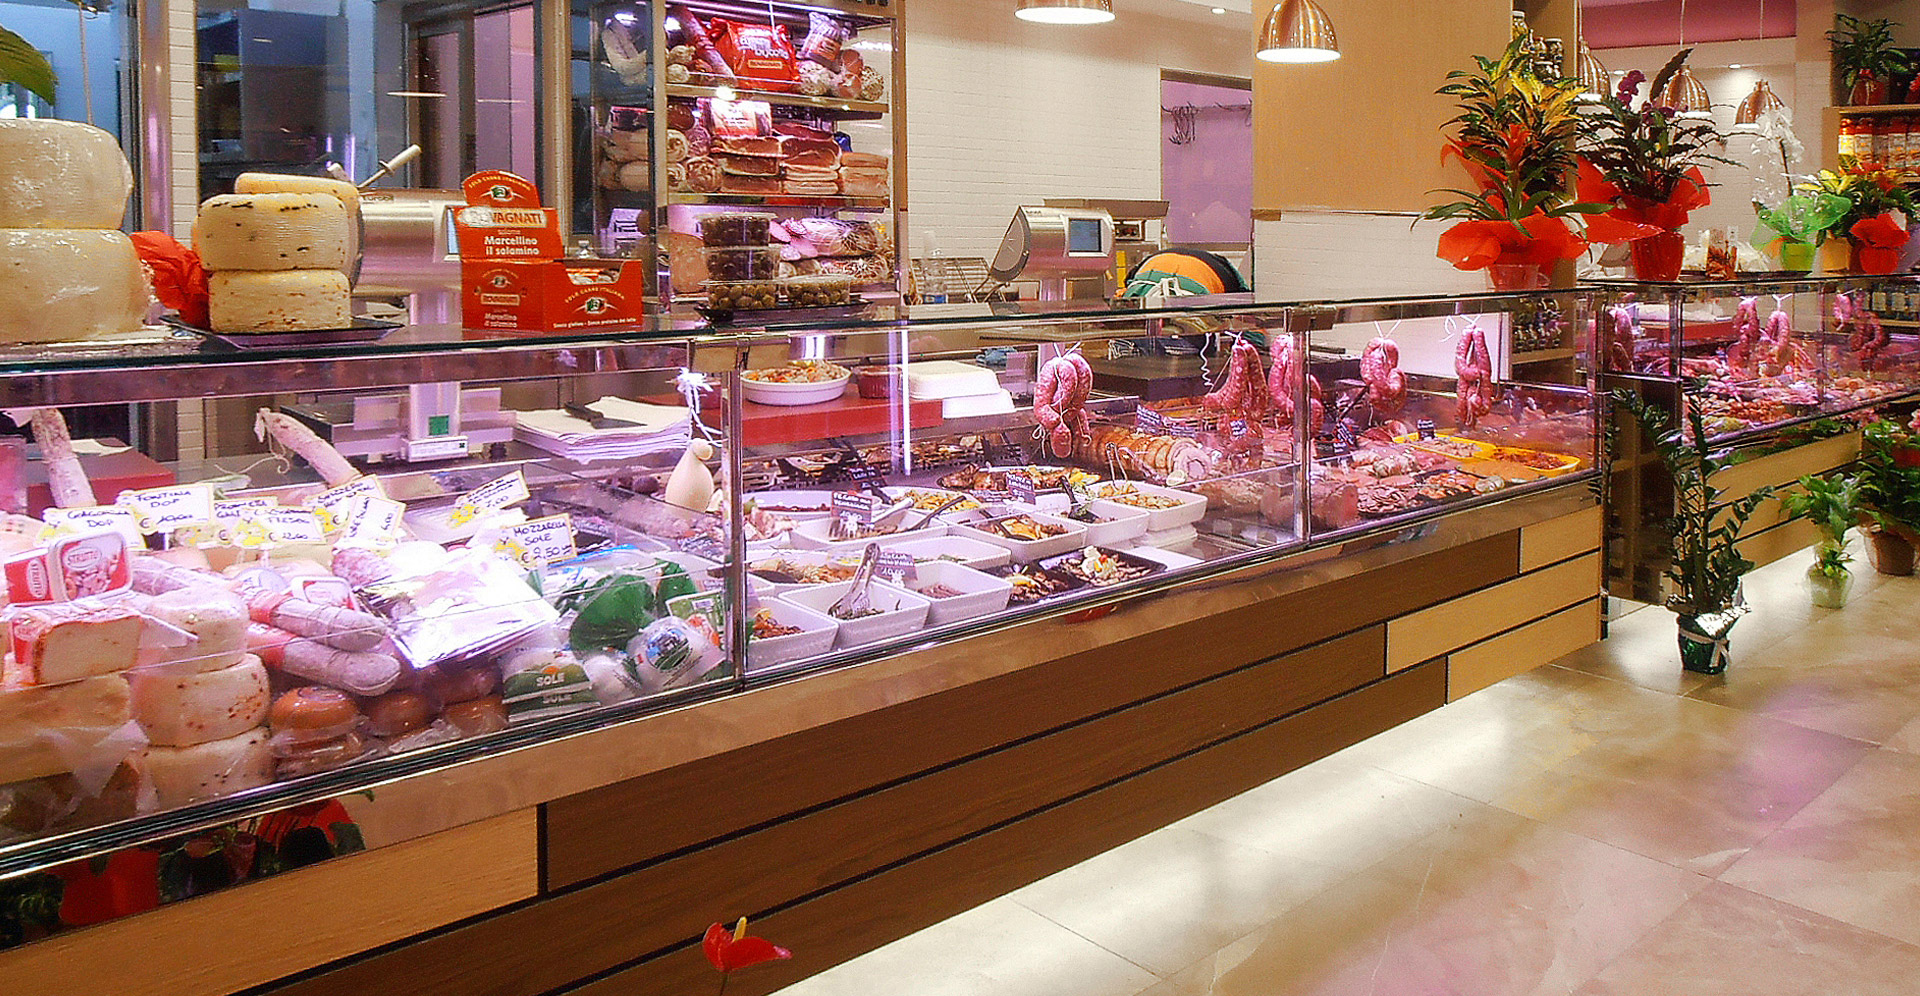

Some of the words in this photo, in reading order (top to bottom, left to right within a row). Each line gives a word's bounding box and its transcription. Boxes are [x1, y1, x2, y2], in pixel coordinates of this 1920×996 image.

[484, 235, 538, 245] Marcellino
[485, 245, 493, 255] il
[495, 245, 540, 255] salamino
[524, 533, 552, 546] SOLE
[536, 673, 565, 687] SOLE
